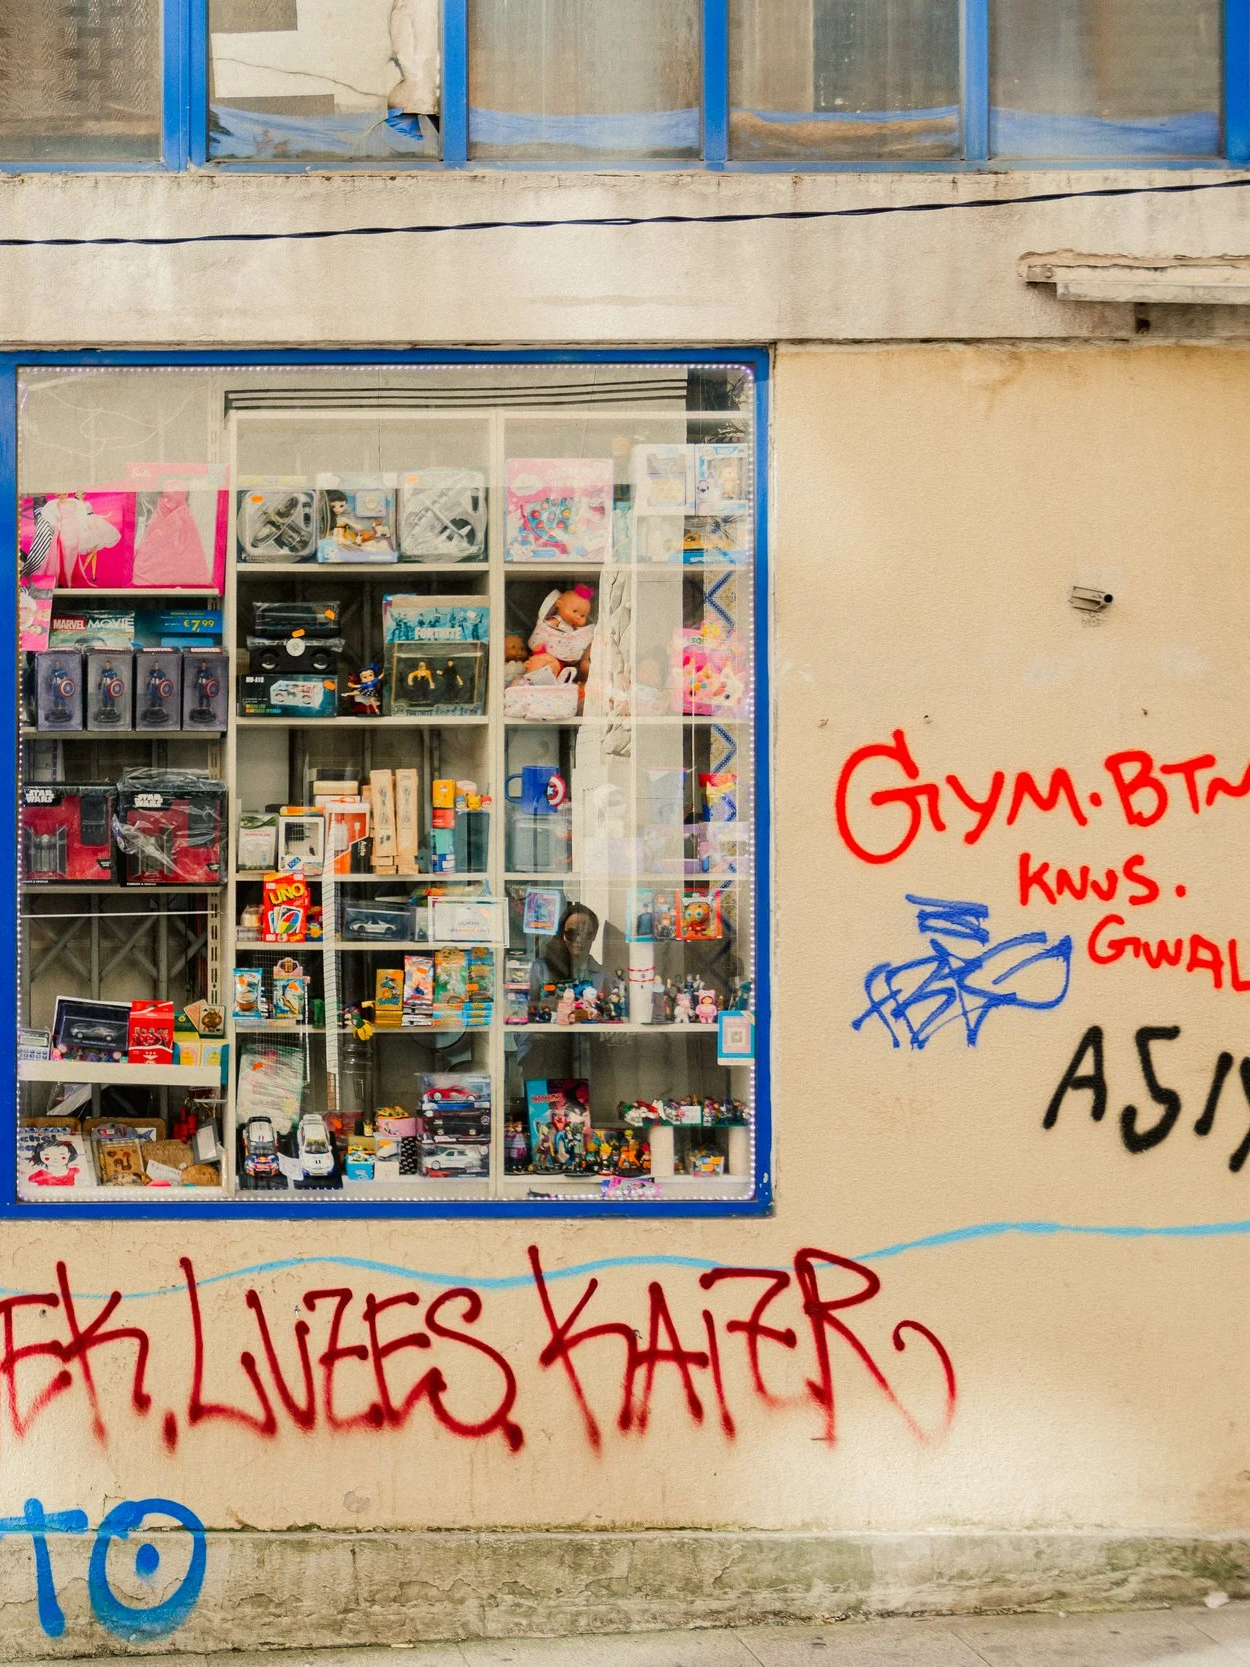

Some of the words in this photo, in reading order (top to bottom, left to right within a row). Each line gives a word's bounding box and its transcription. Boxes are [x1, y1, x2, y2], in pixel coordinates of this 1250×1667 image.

[53, 619, 86, 631] MARVEL
[87, 618, 135, 631] MOVIE
[268, 882, 304, 905] UNO
